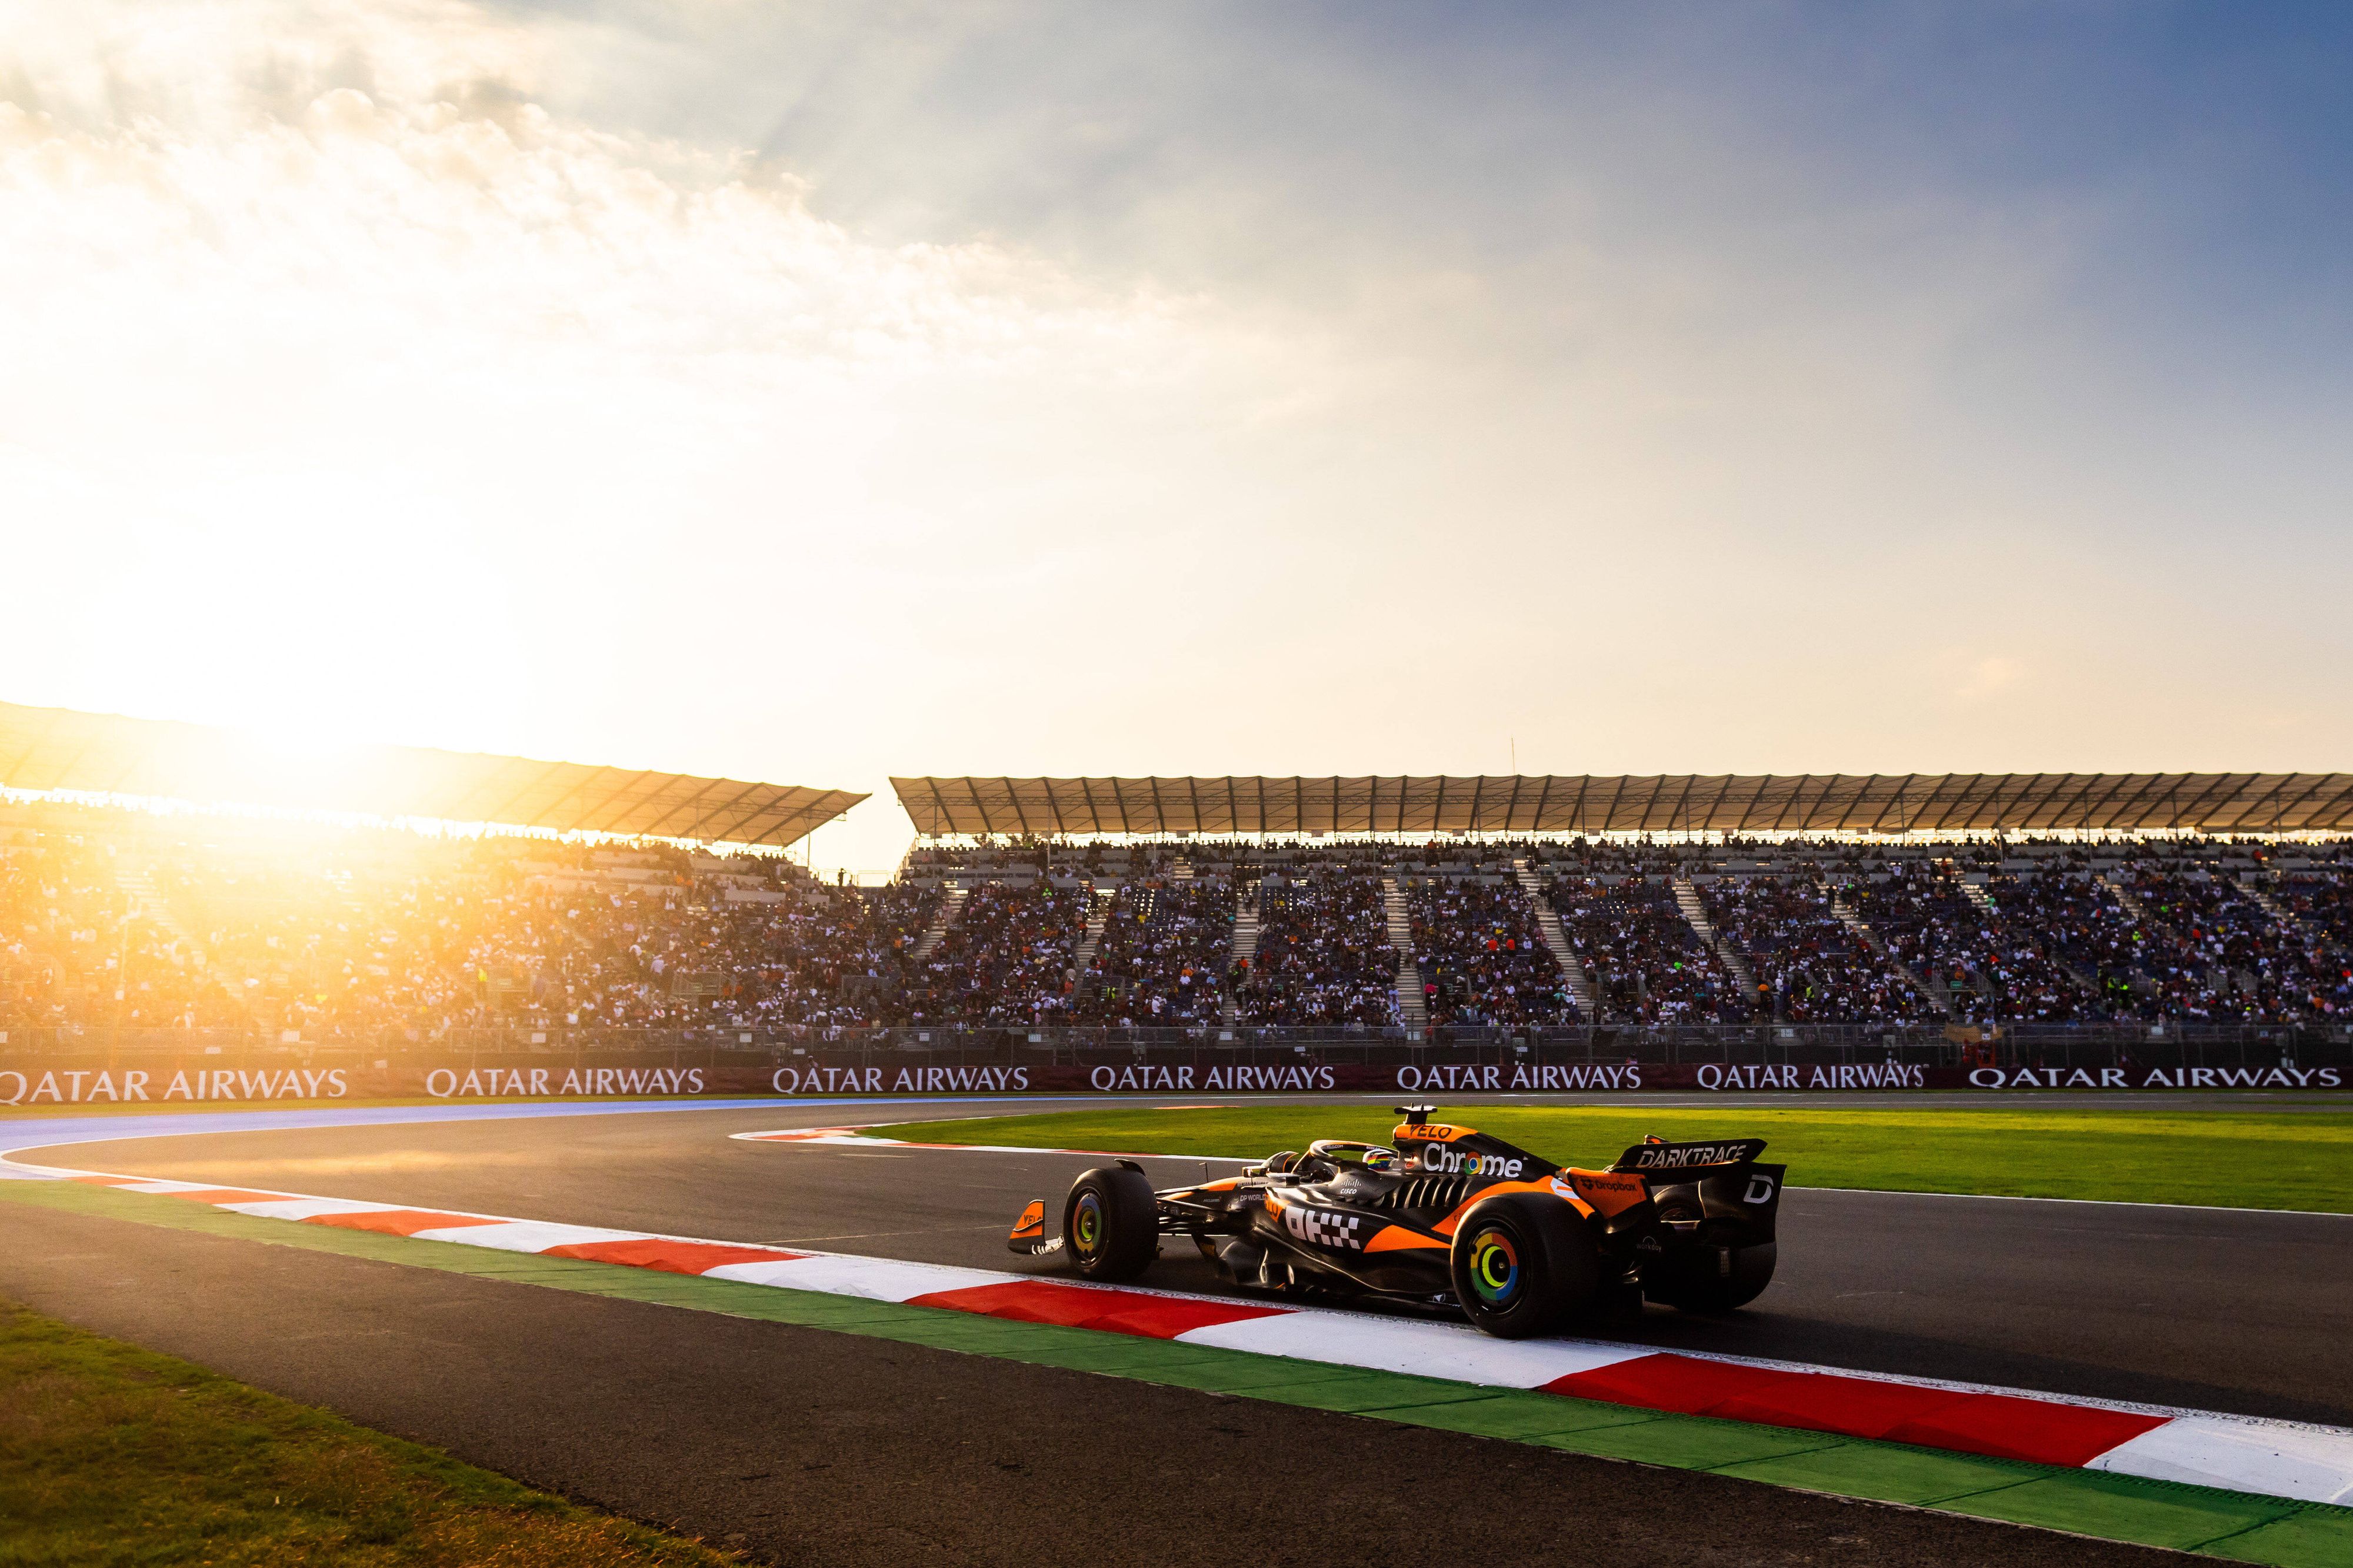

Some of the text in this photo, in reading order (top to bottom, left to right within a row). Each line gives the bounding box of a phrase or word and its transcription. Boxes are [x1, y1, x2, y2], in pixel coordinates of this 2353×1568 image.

[0, 1069, 347, 1106] QATAR AIRWAYS
[426, 1068, 704, 1097] QATAR AIRWAYS
[773, 1067, 1028, 1095] QATAR AIRWAYS
[1091, 1066, 1335, 1091] QATAR AIRWAYS
[1397, 1066, 1641, 1091] QATAR AIRWAYS
[1697, 1065, 1924, 1090] QATAR AIRWAYS
[1969, 1067, 2341, 1089] QATAR AIRWAYS
[1409, 1125, 1452, 1139] VELO
[1424, 1143, 1522, 1178] Chrome
[1636, 1145, 1747, 1168] DARKTRACE
[1595, 1180, 1637, 1192] dropbox
[1743, 1174, 1774, 1204] D
